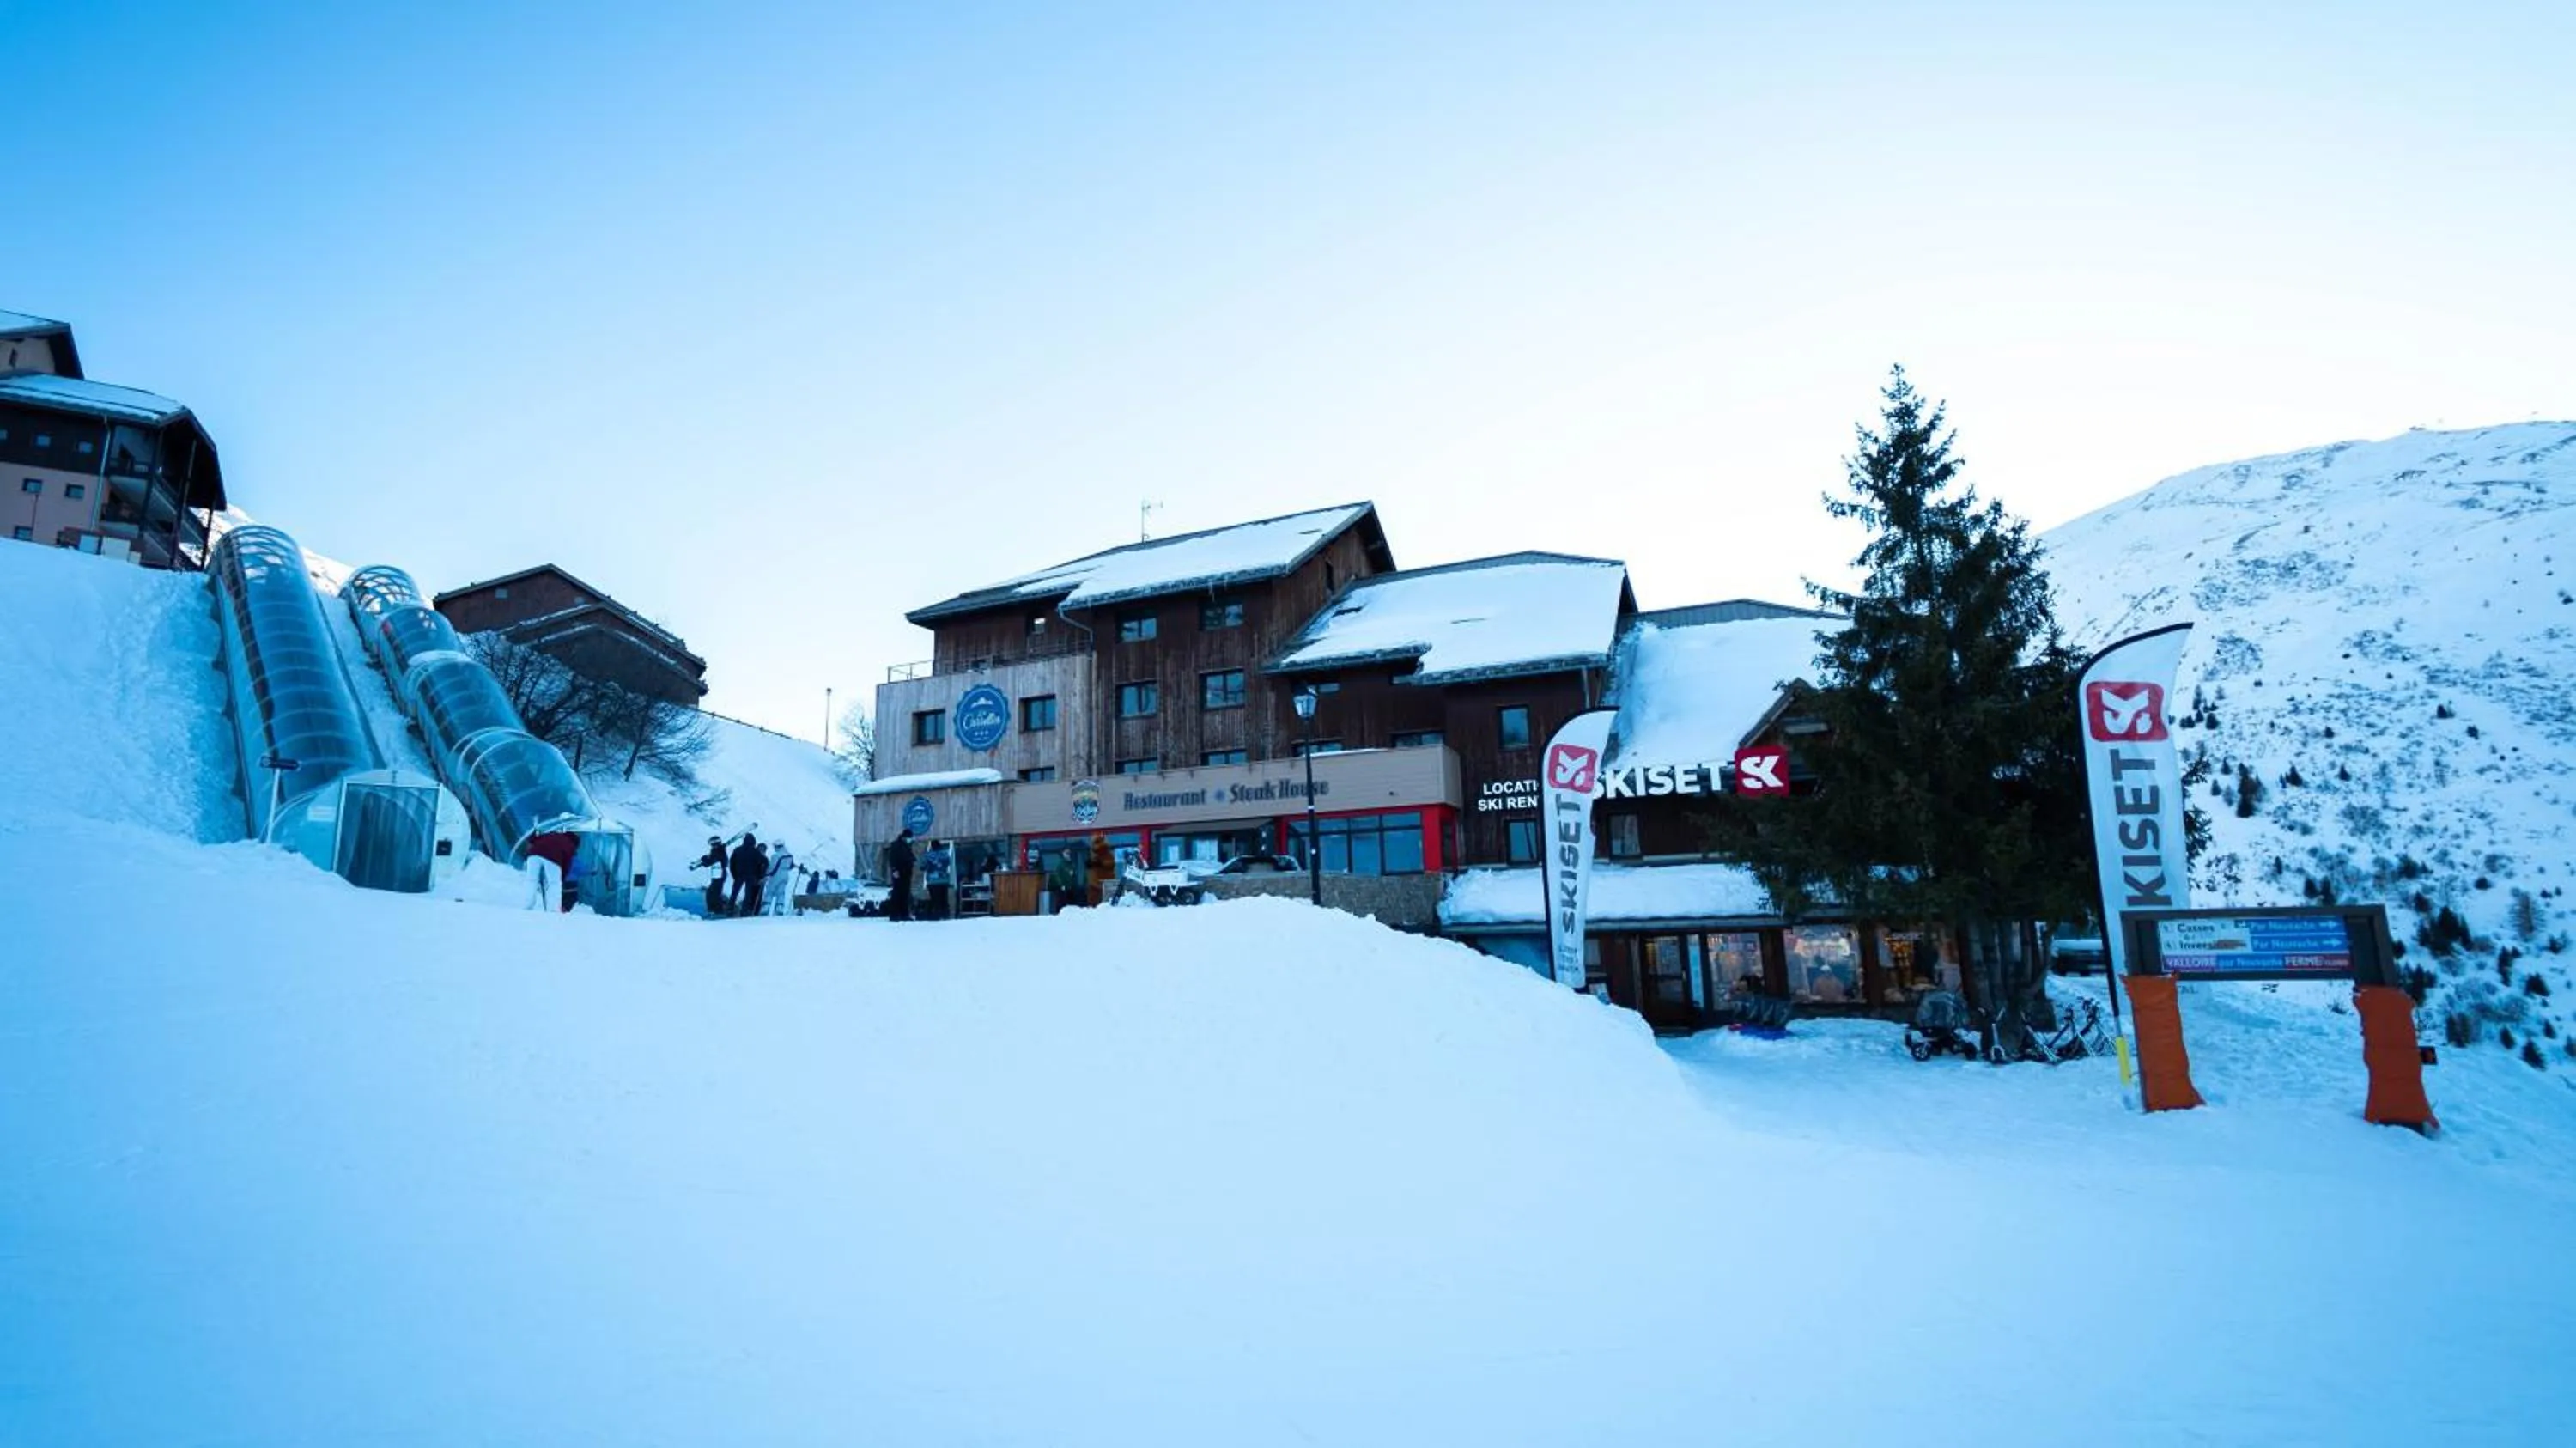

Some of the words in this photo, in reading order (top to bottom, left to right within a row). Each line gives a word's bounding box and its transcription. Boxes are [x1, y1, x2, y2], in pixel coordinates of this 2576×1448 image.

[1123, 788, 1206, 812] Restaurant
[1230, 779, 1276, 804] Steak
[1478, 798, 1503, 812] SKI
[1507, 794, 1540, 810] REN
[1483, 779, 1540, 795] LOCATI
[2110, 748, 2172, 907] KISET
[1556, 793, 1581, 936] SKISET
